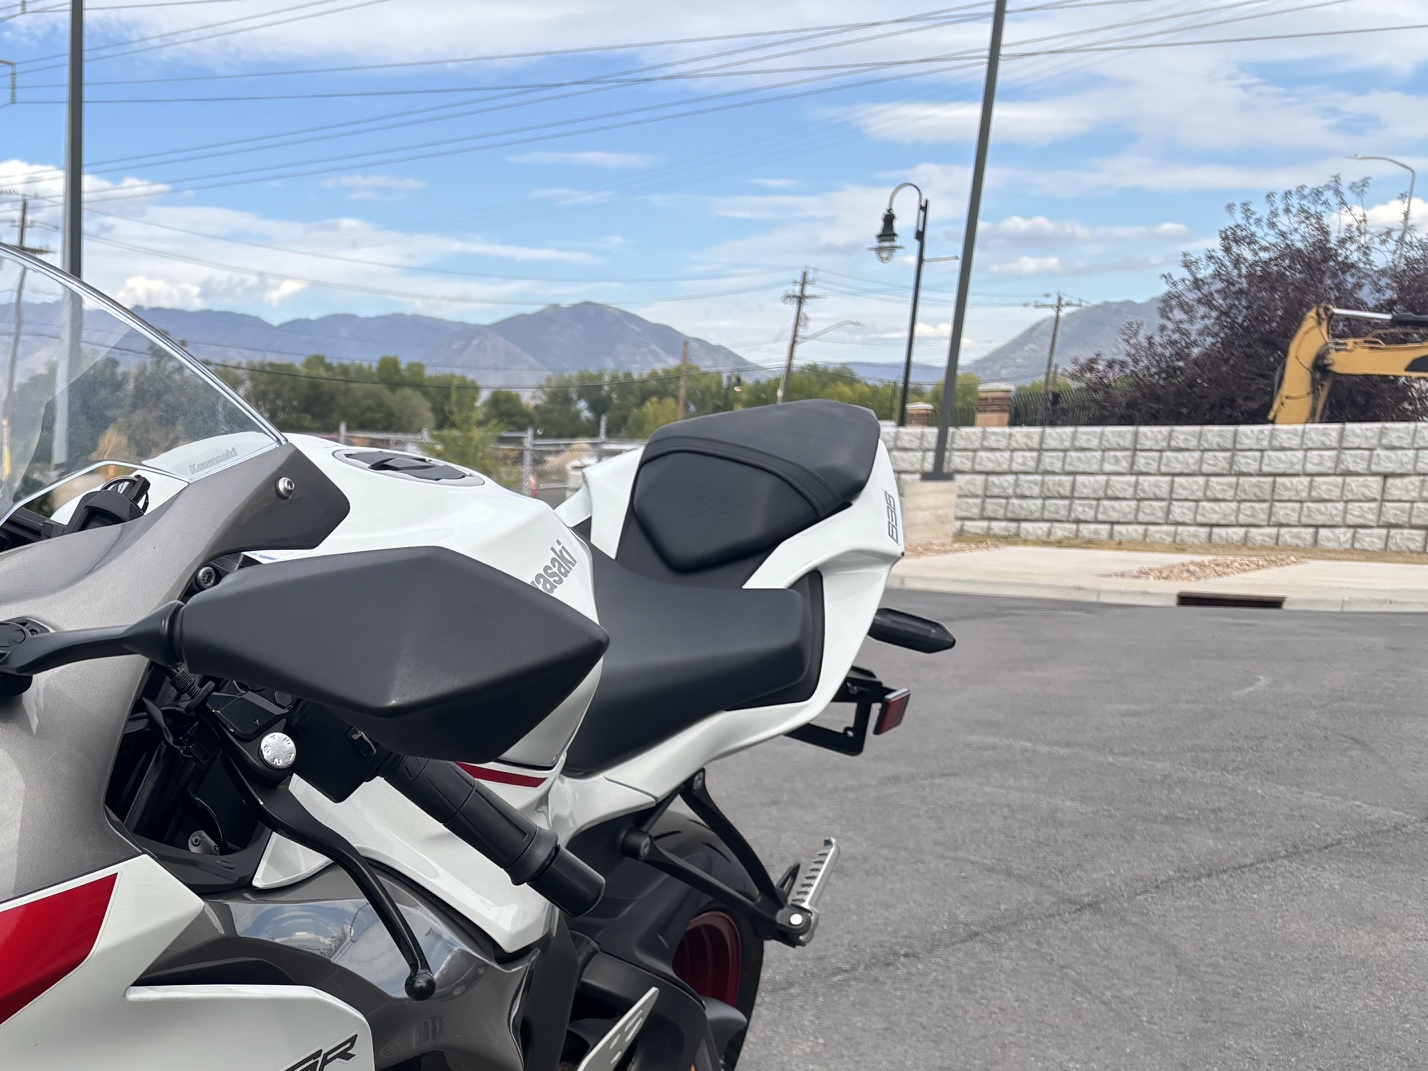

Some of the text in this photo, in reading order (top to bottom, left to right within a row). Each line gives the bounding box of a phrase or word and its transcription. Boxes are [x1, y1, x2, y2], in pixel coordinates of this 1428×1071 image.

[189, 447, 237, 474] Kawasaki
[884, 490, 898, 544] 636
[529, 539, 577, 594] asaki
